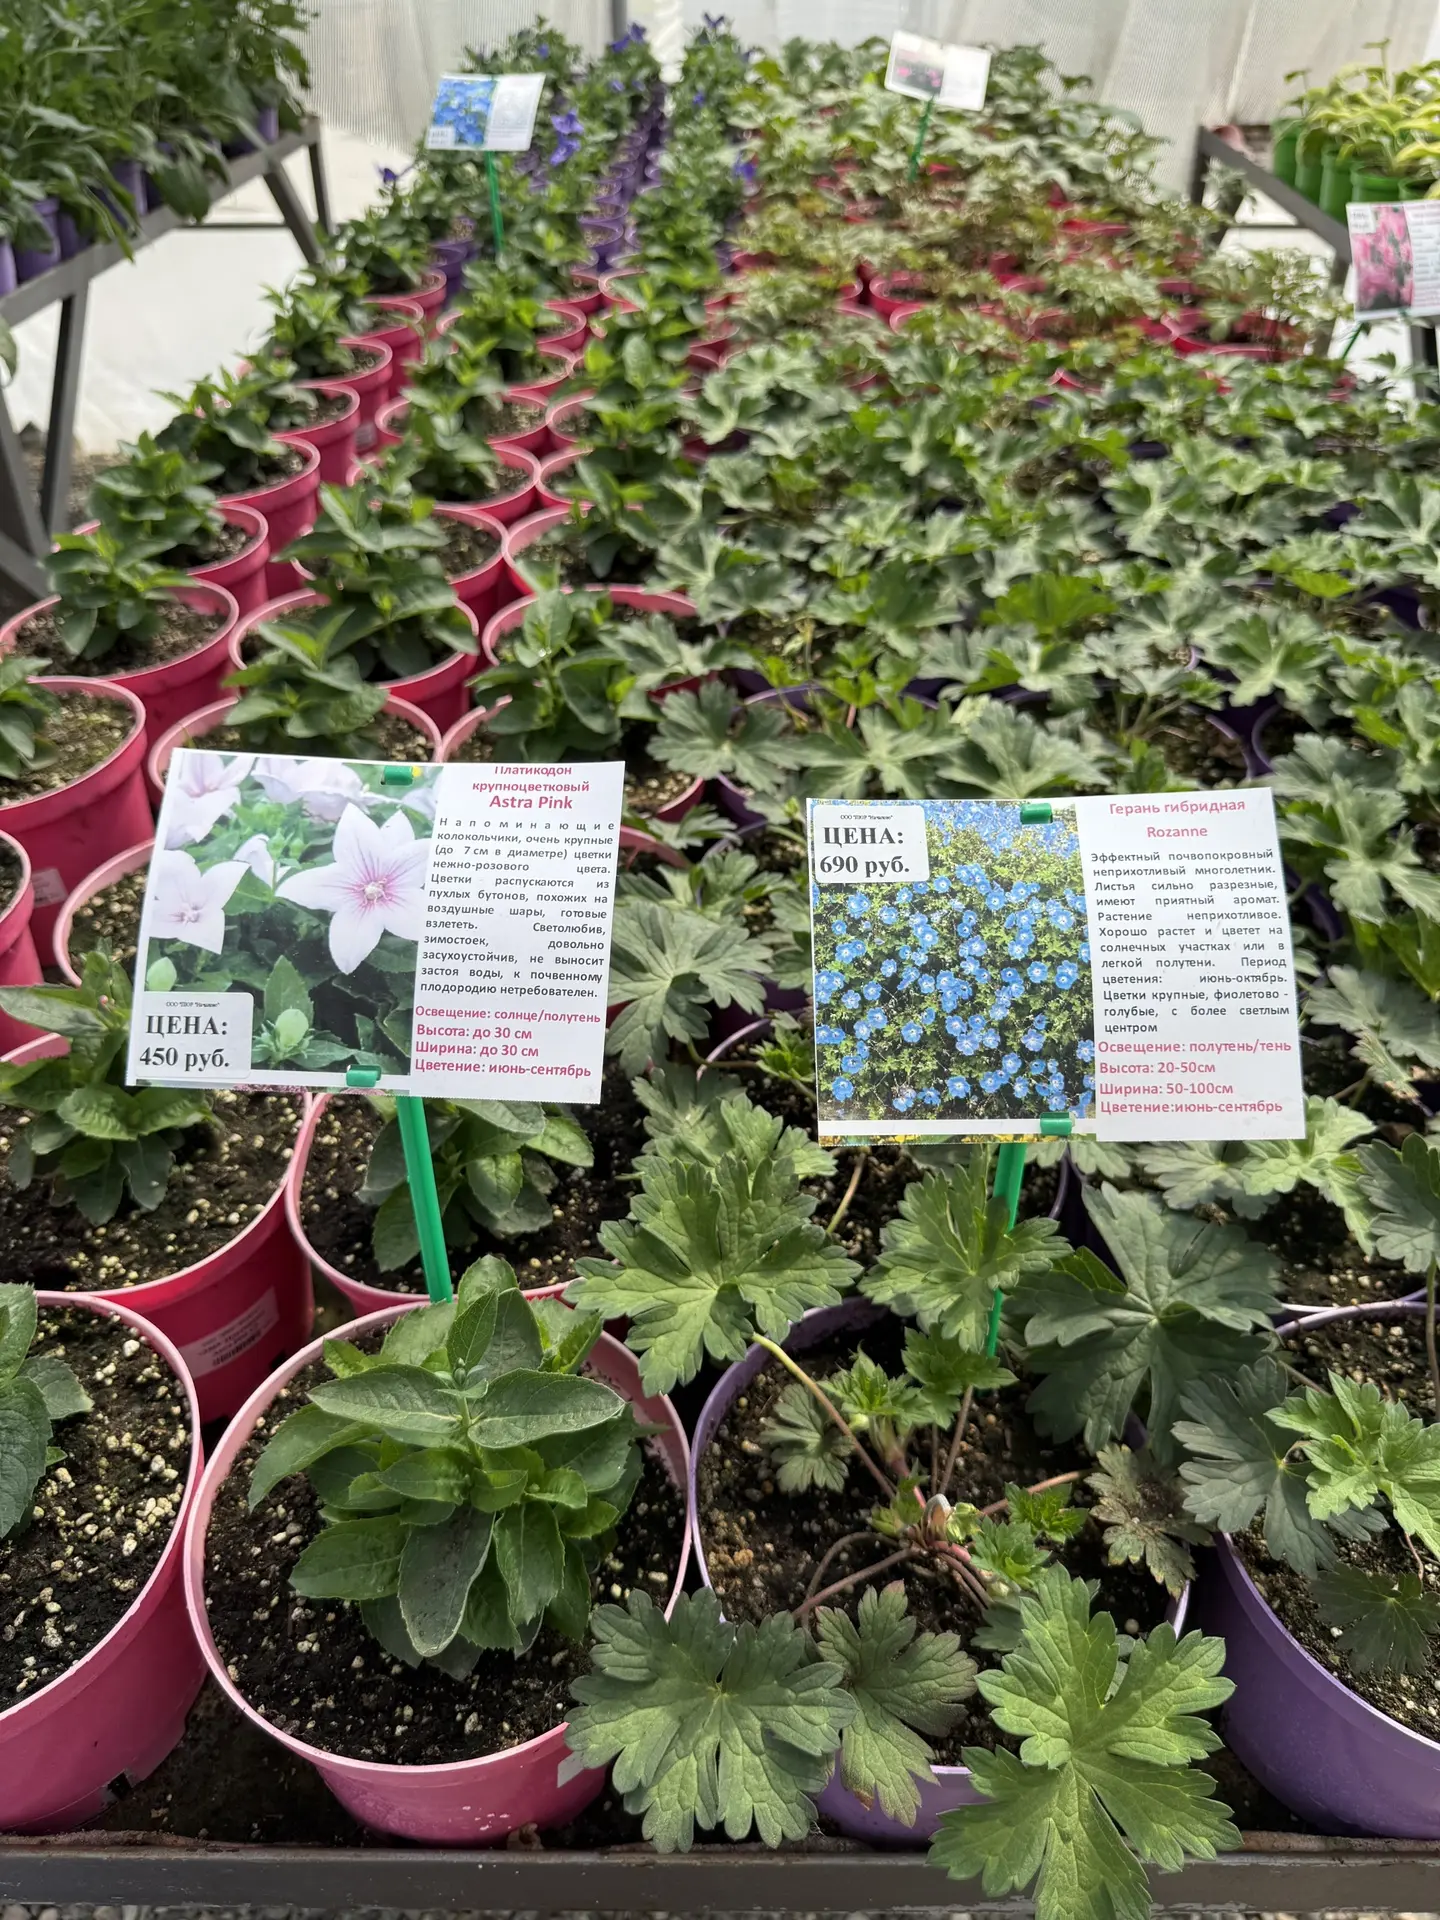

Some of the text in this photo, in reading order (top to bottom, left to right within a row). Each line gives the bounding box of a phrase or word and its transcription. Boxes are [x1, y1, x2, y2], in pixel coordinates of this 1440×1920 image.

[472, 781, 589, 793] крупноцветковый
[490, 795, 572, 809] Astra Pink
[1110, 800, 1246, 816] Герань гибридная
[437, 832, 613, 846] колокольчики, очень крупные
[823, 827, 904, 848] ЦЕНА:
[1147, 826, 1208, 838] Rozanne
[436, 845, 453, 856] (до
[474, 848, 488, 856] см
[507, 849, 567, 860] диаметре)
[574, 852, 612, 860] цветки
[1091, 849, 1273, 863] Эффектный почвопокровный
[433, 861, 610, 875] нежно-розового цвета.
[820, 856, 910, 878] 690 руб.
[1093, 865, 1275, 878] неприхотливый многолетник.
[431, 874, 472, 885] Цветки
[495, 878, 574, 888] распускаются
[1095, 881, 1277, 891] Листья сильно разрезные,
[429, 890, 608, 904] пухлых бутонов, похожих на
[1096, 896, 1279, 907] имеют приятный аромат.
[428, 905, 607, 918] воздушные шары, готовые
[1098, 912, 1281, 922] Растение неприхотливое.
[426, 920, 606, 935] взлететь. Светолюбив,
[1099, 928, 1147, 938] Хорошо
[1158, 928, 1195, 938] растет
[1222, 927, 1260, 936] цветет
[424, 935, 604, 950] зимостоек, довольно
[1100, 944, 1166, 952] солнечных
[1179, 943, 1230, 953] участках
[1243, 943, 1265, 951] или
[423, 952, 604, 966] засухоустойчив, не выносит
[1101, 957, 1286, 969] легкой полутени. Период
[422, 967, 459, 977] застоя
[470, 969, 503, 979] воды,
[531, 972, 602, 983] почвенному
[1103, 972, 1287, 985] цветения: июнь-октябрь.
[421, 983, 598, 998] плодородию нетребователен.
[1103, 991, 1146, 1002] Цветки
[1152, 991, 1208, 1002] крупные,
[416, 1006, 601, 1024] Освещение: солнце/полутень
[1104, 1006, 1289, 1018] голубые, с более светлым
[146, 1015, 228, 1038] ЦЕНА:
[417, 1024, 532, 1040] Высота: до 30 см
[1105, 1024, 1158, 1034] центром
[416, 1041, 539, 1057] Ширина: до 30 см
[1098, 1039, 1291, 1054] Освещение: полутень/тень
[140, 1047, 230, 1072] 450 руб.
[415, 1059, 591, 1079] Цветение: июнь-сентябрь
[1100, 1062, 1216, 1074] Высота: 20-50см
[1100, 1082, 1233, 1097] Ширина: 50-100см
